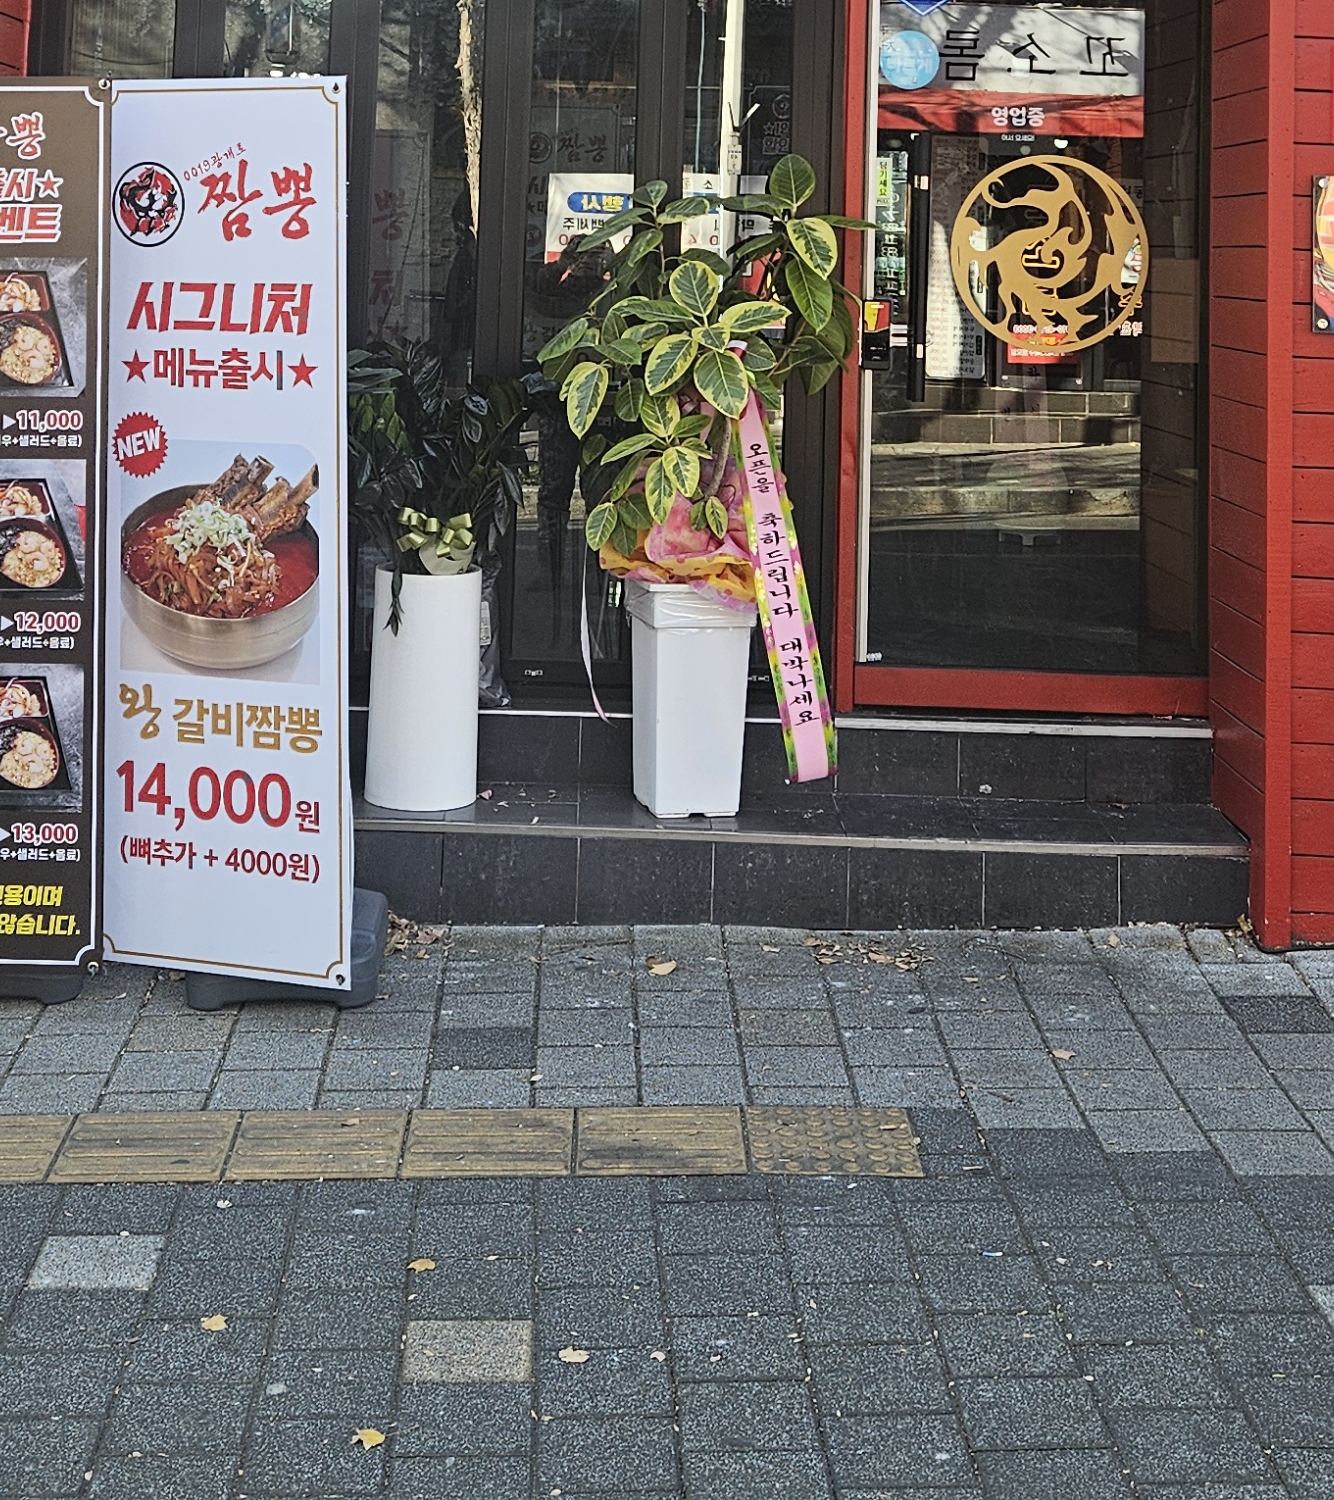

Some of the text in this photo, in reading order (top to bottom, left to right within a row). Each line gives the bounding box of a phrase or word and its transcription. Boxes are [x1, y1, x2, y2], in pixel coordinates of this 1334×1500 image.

[991, 107, 1045, 127] 영업중
[198, 159, 317, 241] 짬뽕
[126, 281, 313, 336] 시그니처
[153, 348, 284, 390] 메뉴출시
[16, 410, 82, 433] 11,000
[117, 426, 162, 460] NEW
[745, 443, 821, 727] 오픈을 축하드립니다 대박나세요
[14, 612, 80, 634] 12,000
[119, 683, 323, 754] 왕 갈비짬뽕
[116, 760, 321, 835] 14,000원
[10, 823, 79, 846] 13,000
